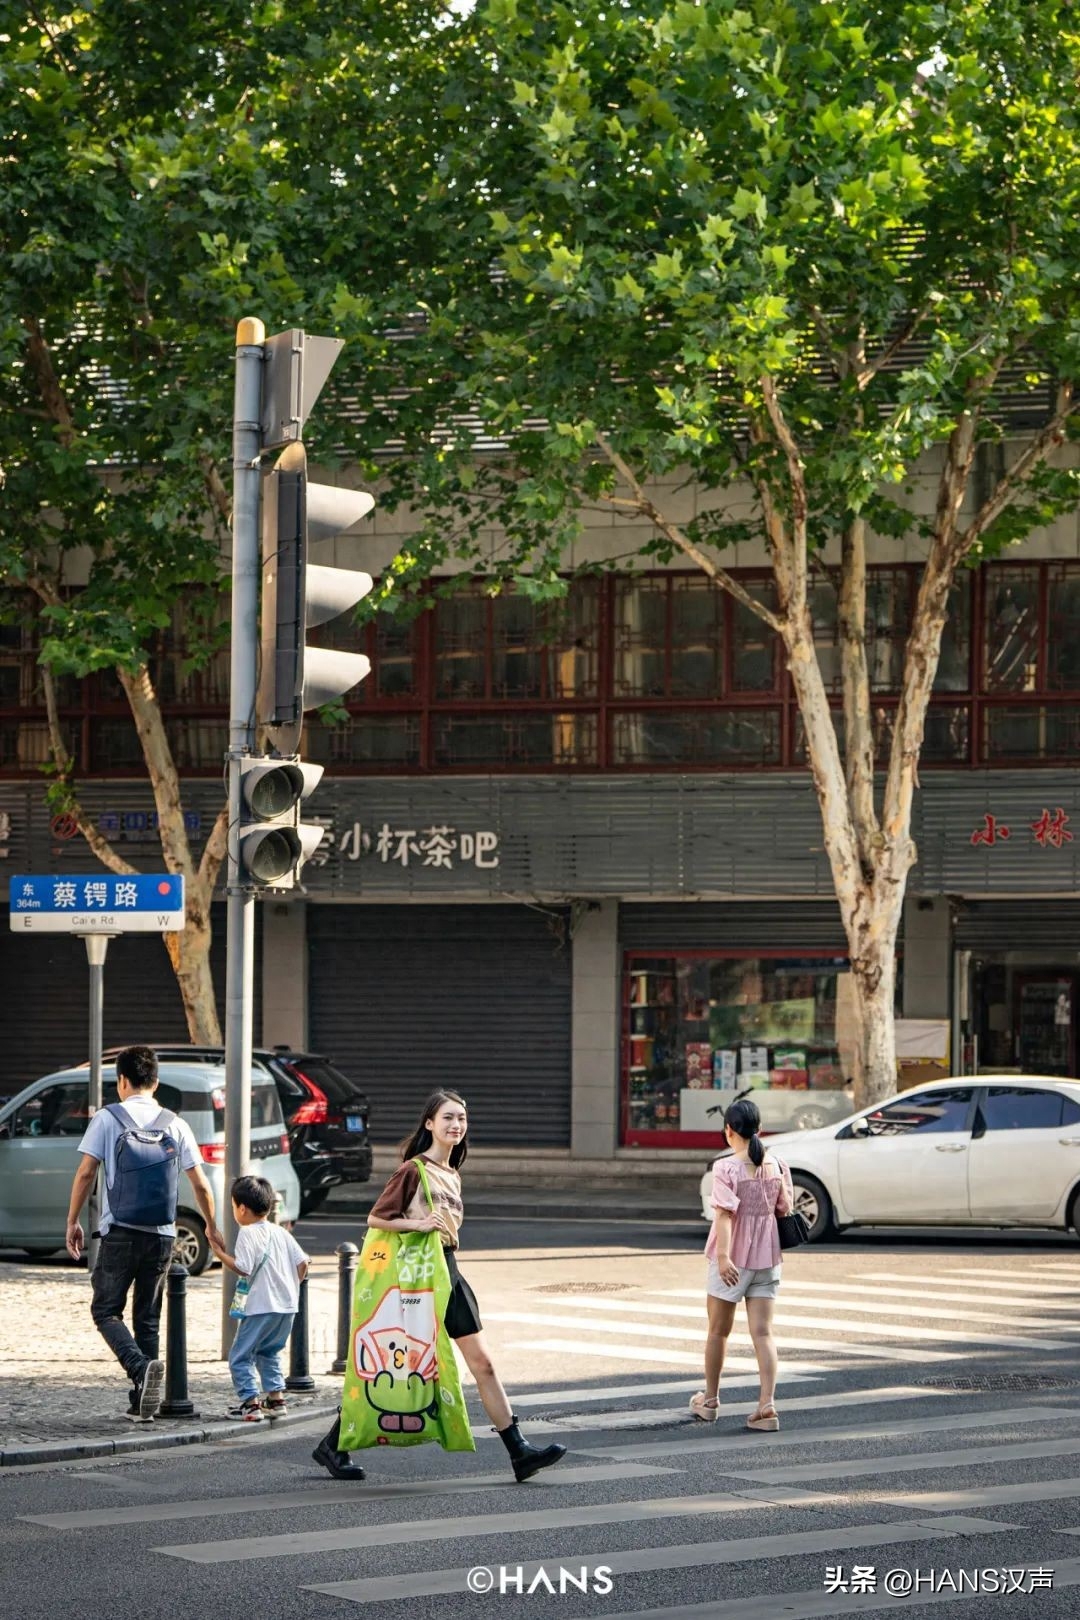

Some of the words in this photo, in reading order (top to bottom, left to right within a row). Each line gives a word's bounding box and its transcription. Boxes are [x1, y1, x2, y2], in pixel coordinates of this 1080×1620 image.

[970, 807, 1074, 848] 小林
[22, 883, 35, 896] 东
[53, 881, 138, 908] 蔡锷路
[16, 899, 41, 909] 364m
[24, 916, 32, 927] E
[100, 915, 117, 925] Rd.
[157, 916, 170, 926] W
